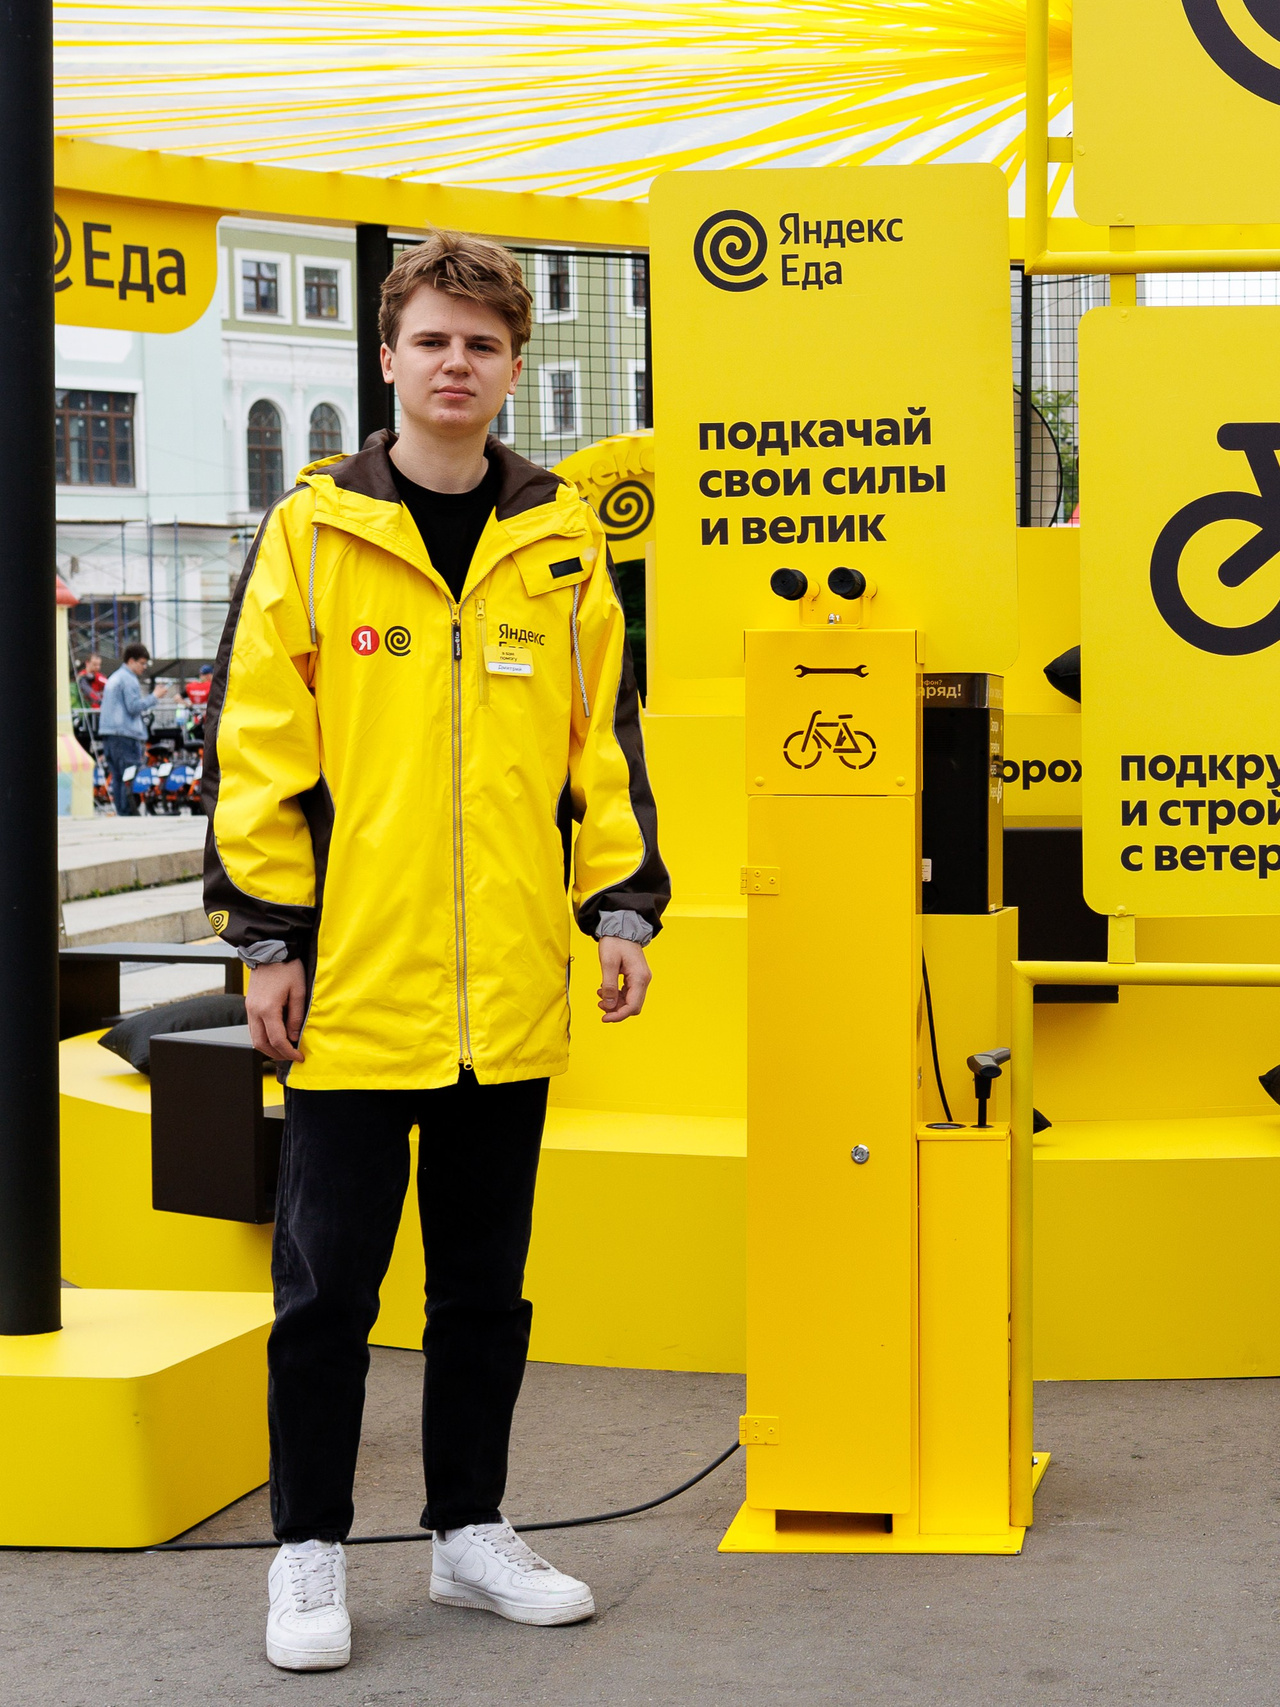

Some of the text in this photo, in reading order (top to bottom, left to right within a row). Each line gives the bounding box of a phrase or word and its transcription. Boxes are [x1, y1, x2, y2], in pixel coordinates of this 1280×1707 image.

[779, 212, 904, 248] Яндекс
[83, 221, 187, 304] Еда
[781, 253, 843, 291] Еда
[699, 406, 932, 456] подкачай
[698, 464, 946, 499] свои силы
[701, 513, 887, 546] и велик
[358, 630, 372, 650] Я
[498, 623, 546, 646] Яндекс
[1121, 800, 1148, 827] и
[1120, 844, 1143, 872] с
